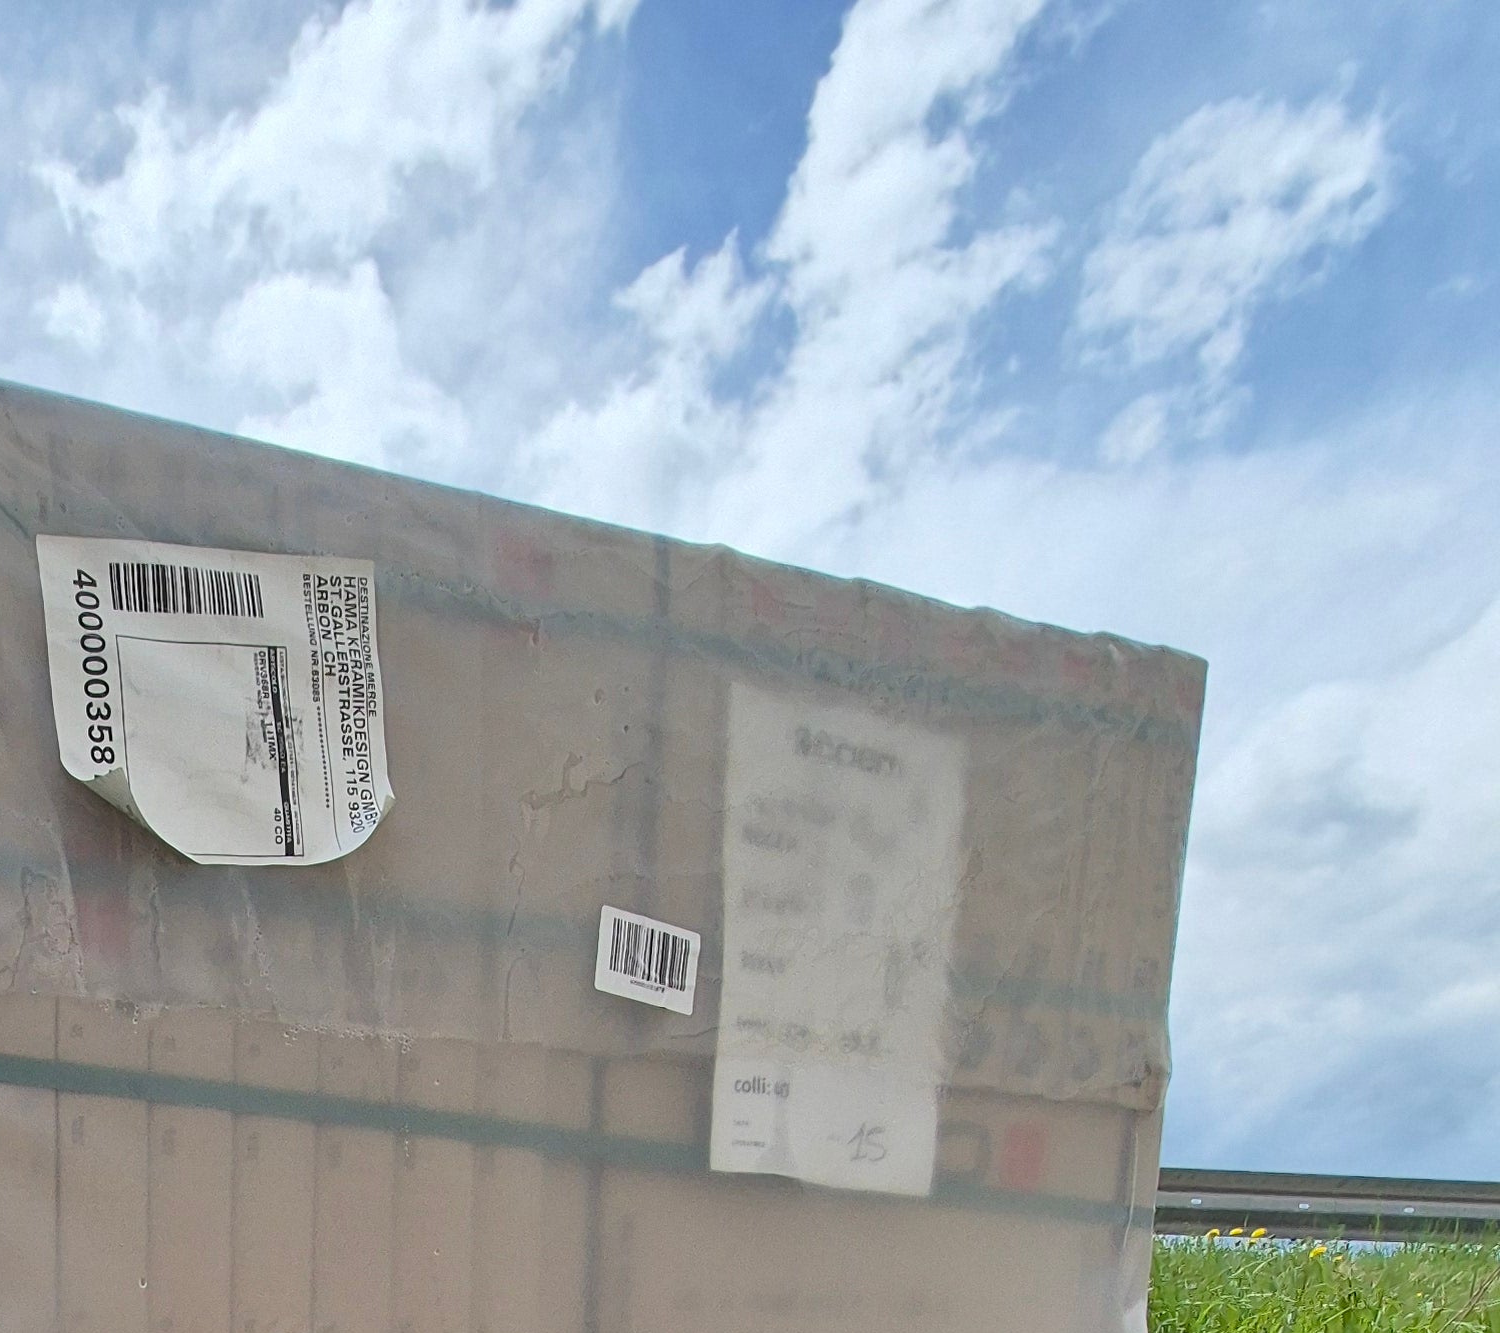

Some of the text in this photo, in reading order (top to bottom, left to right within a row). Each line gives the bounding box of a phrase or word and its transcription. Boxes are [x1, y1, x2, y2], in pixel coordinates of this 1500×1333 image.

[302, 573, 318, 646] BESTELLUNG
[316, 574, 337, 677] ARBON CH
[343, 575, 358, 631] HAMA
[72, 568, 116, 772] 400000358
[360, 576, 377, 718] DESTINAZIONE MERCE
[347, 635, 370, 784] KERAMIKDESIGN
[345, 770, 359, 797] 115
[348, 802, 366, 835] 9320
[734, 1075, 771, 1096] colli:
